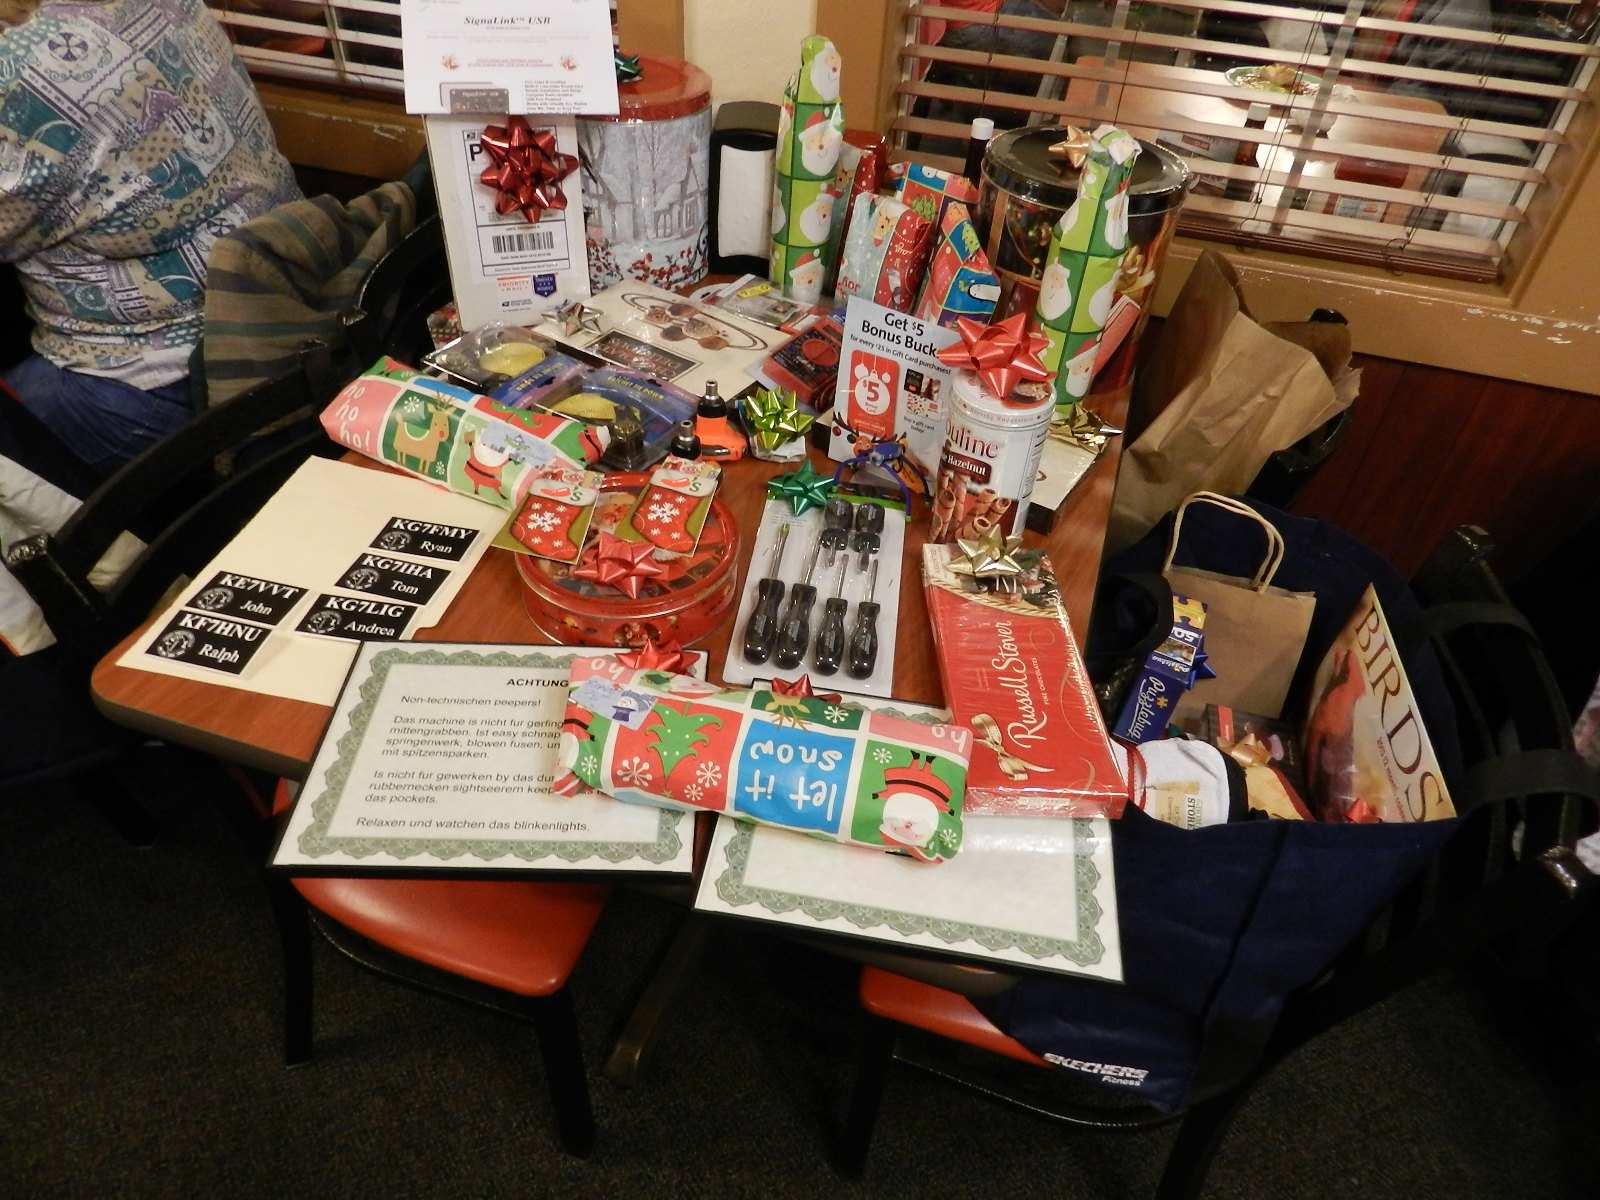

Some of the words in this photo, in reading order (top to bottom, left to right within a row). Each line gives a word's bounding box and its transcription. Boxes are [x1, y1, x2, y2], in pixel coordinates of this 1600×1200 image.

[528, 16, 552, 25] USB
[884, 312, 908, 332] Get
[912, 321, 925, 337] $5
[861, 319, 902, 345] Bonus
[904, 335, 940, 359] Buck
[860, 338, 876, 349] every
[892, 349, 905, 359] Gift
[904, 354, 919, 364] Card
[919, 359, 952, 376] purchases!
[335, 399, 360, 422] ho
[340, 421, 371, 453] ho!
[947, 454, 987, 477] Hazelnut
[391, 518, 474, 540] KG7FMY
[420, 540, 453, 554] Ryan
[361, 554, 434, 580] KG7IHA
[219, 573, 300, 600] KE7VVT
[390, 580, 420, 595] Tom
[239, 600, 273, 616] John
[324, 595, 406, 618] KG7LIG
[178, 613, 265, 643] KF7HNU
[343, 620, 397, 638] Andrea
[197, 643, 241, 664] Ralph
[991, 619, 1027, 675] Stover
[506, 678, 570, 688] ACHTUNG
[400, 695, 492, 706] Non-technischen
[493, 698, 542, 708] peepers!
[999, 669, 1048, 749] Russell
[1127, 675, 1167, 741] Puzzlebug
[392, 715, 417, 725] Das
[418, 716, 467, 726] machine
[467, 717, 479, 726] is
[479, 717, 508, 727] nicht
[1355, 605, 1448, 822] BIRDS
[466, 738, 508, 748] blowen
[475, 728, 489, 738] Ist
[491, 729, 518, 739] easy
[380, 748, 400, 757] mit
[749, 739, 843, 772] snow
[368, 781, 451, 792] rubbernecken
[372, 769, 385, 779] Is
[386, 769, 416, 780] nicht
[436, 772, 493, 783] gewerken
[495, 773, 510, 784] by
[512, 773, 535, 783] das
[744, 768, 776, 802] it
[364, 793, 387, 803] das
[388, 794, 439, 805] pockets.
[788, 775, 838, 822] let
[355, 816, 407, 828] Relaxen
[408, 818, 433, 828] und
[435, 818, 486, 830] watchen
[488, 819, 511, 830] das
[513, 820, 591, 833] blinkenlights.
